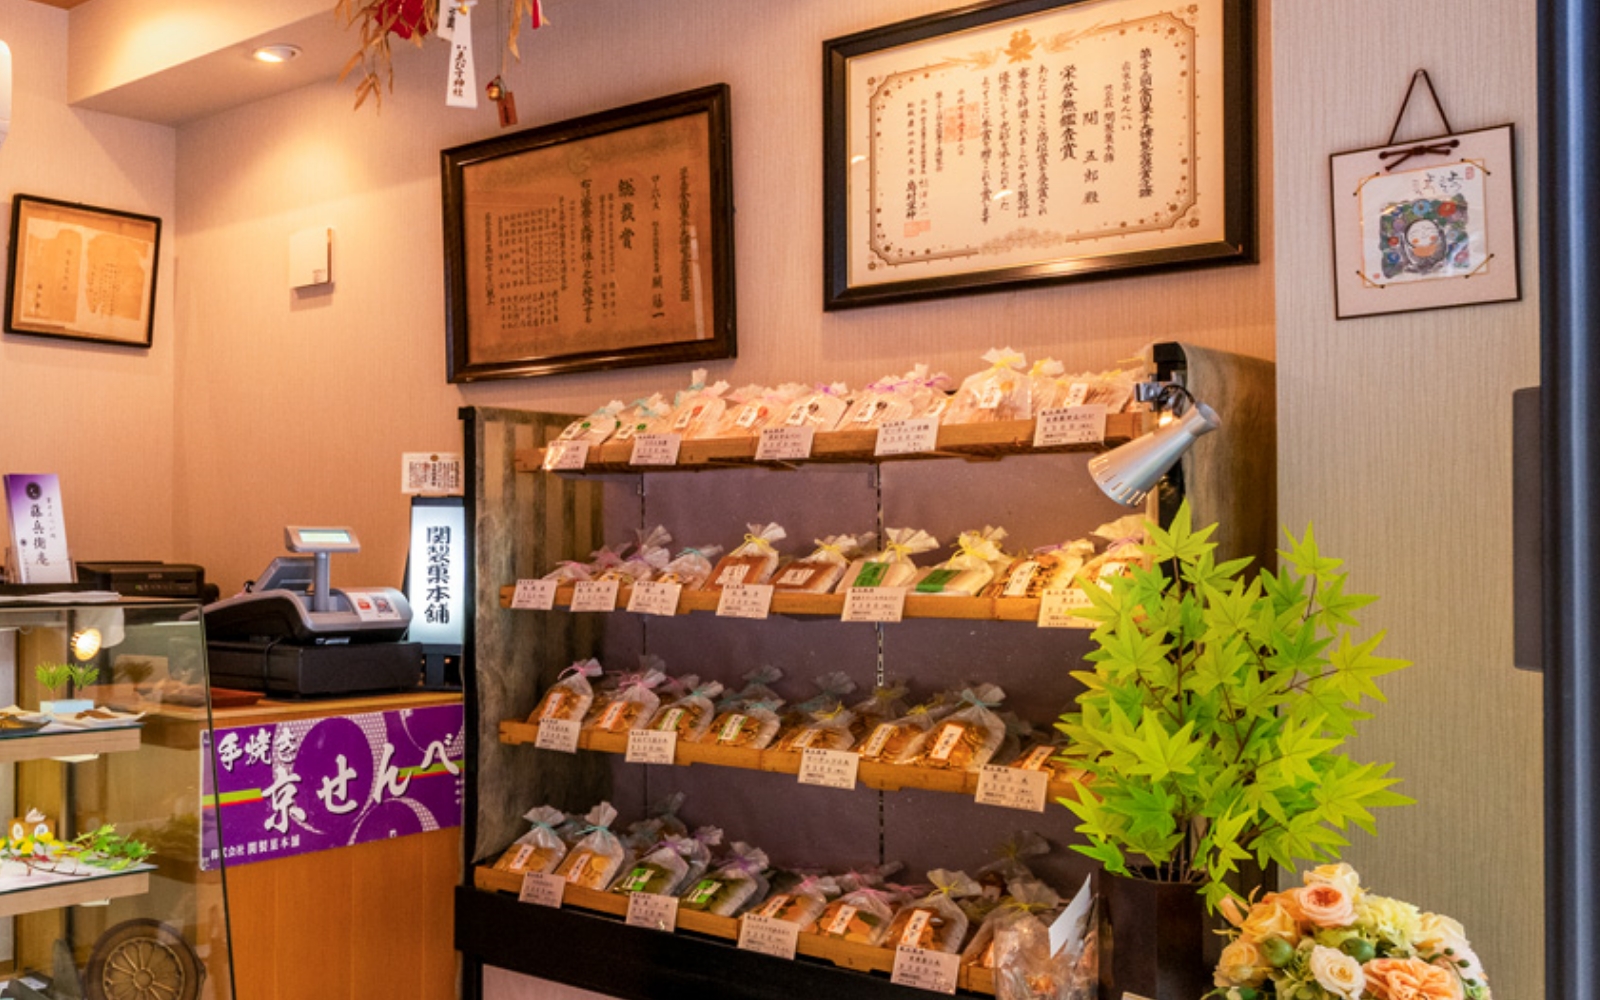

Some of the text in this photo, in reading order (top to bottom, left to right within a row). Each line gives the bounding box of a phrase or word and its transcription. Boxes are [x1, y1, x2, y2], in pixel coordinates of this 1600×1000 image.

[425, 526, 451, 624] 関製菓本舗
[218, 727, 299, 773] 手焼き
